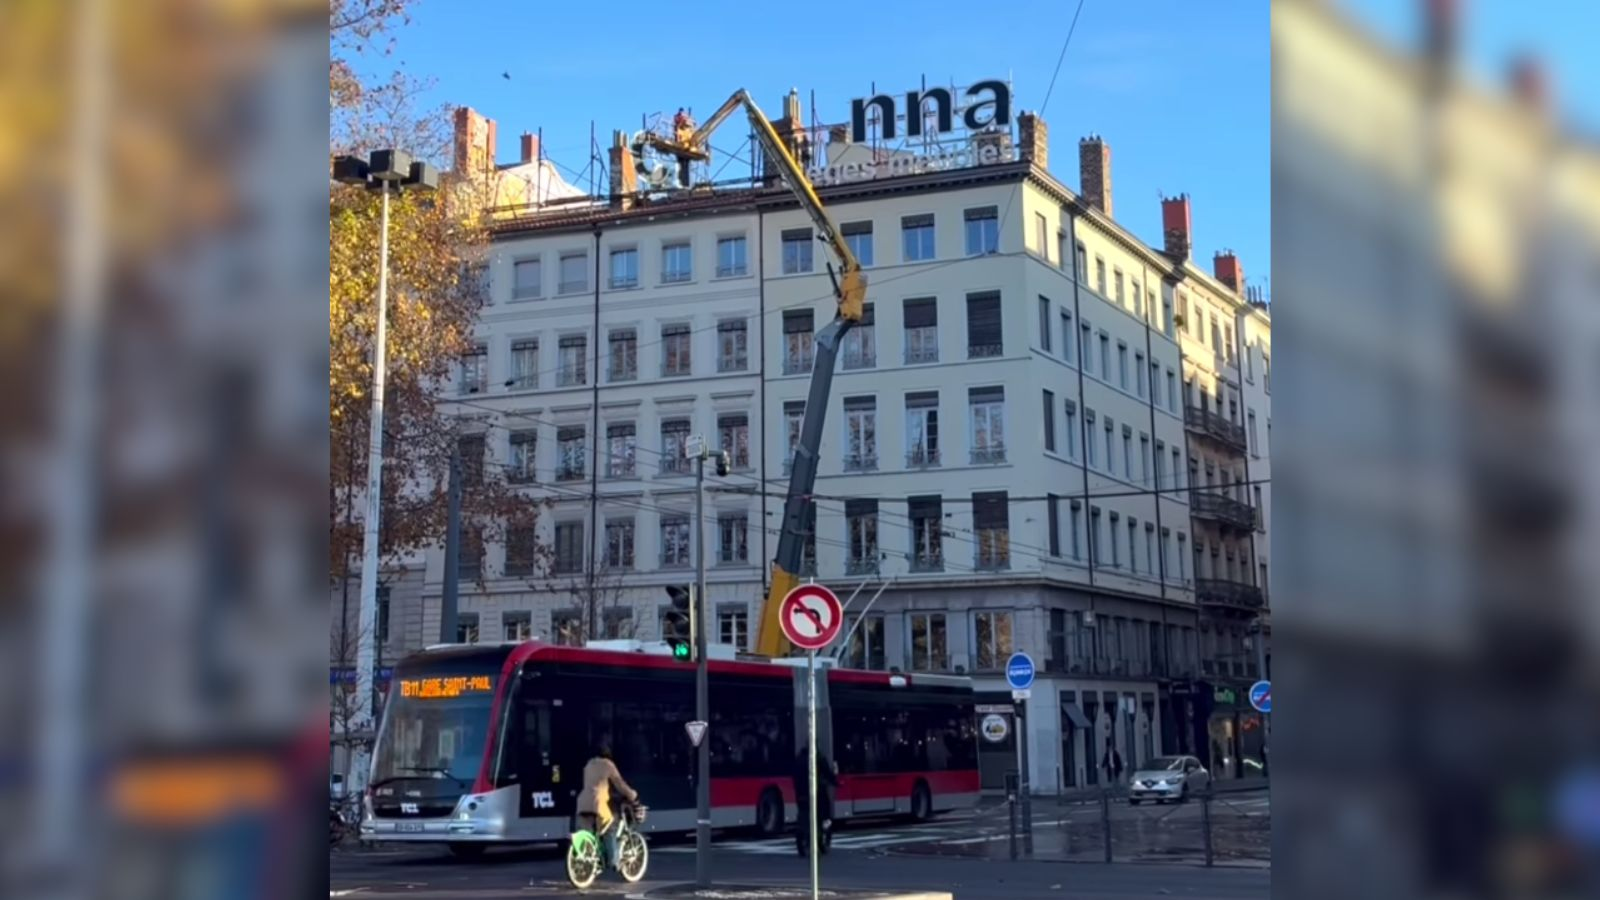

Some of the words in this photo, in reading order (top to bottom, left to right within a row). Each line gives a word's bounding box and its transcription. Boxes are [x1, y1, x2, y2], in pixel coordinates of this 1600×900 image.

[852, 80, 1010, 143] nna
[532, 791, 555, 808] TCL
[401, 803, 419, 814] TCL
